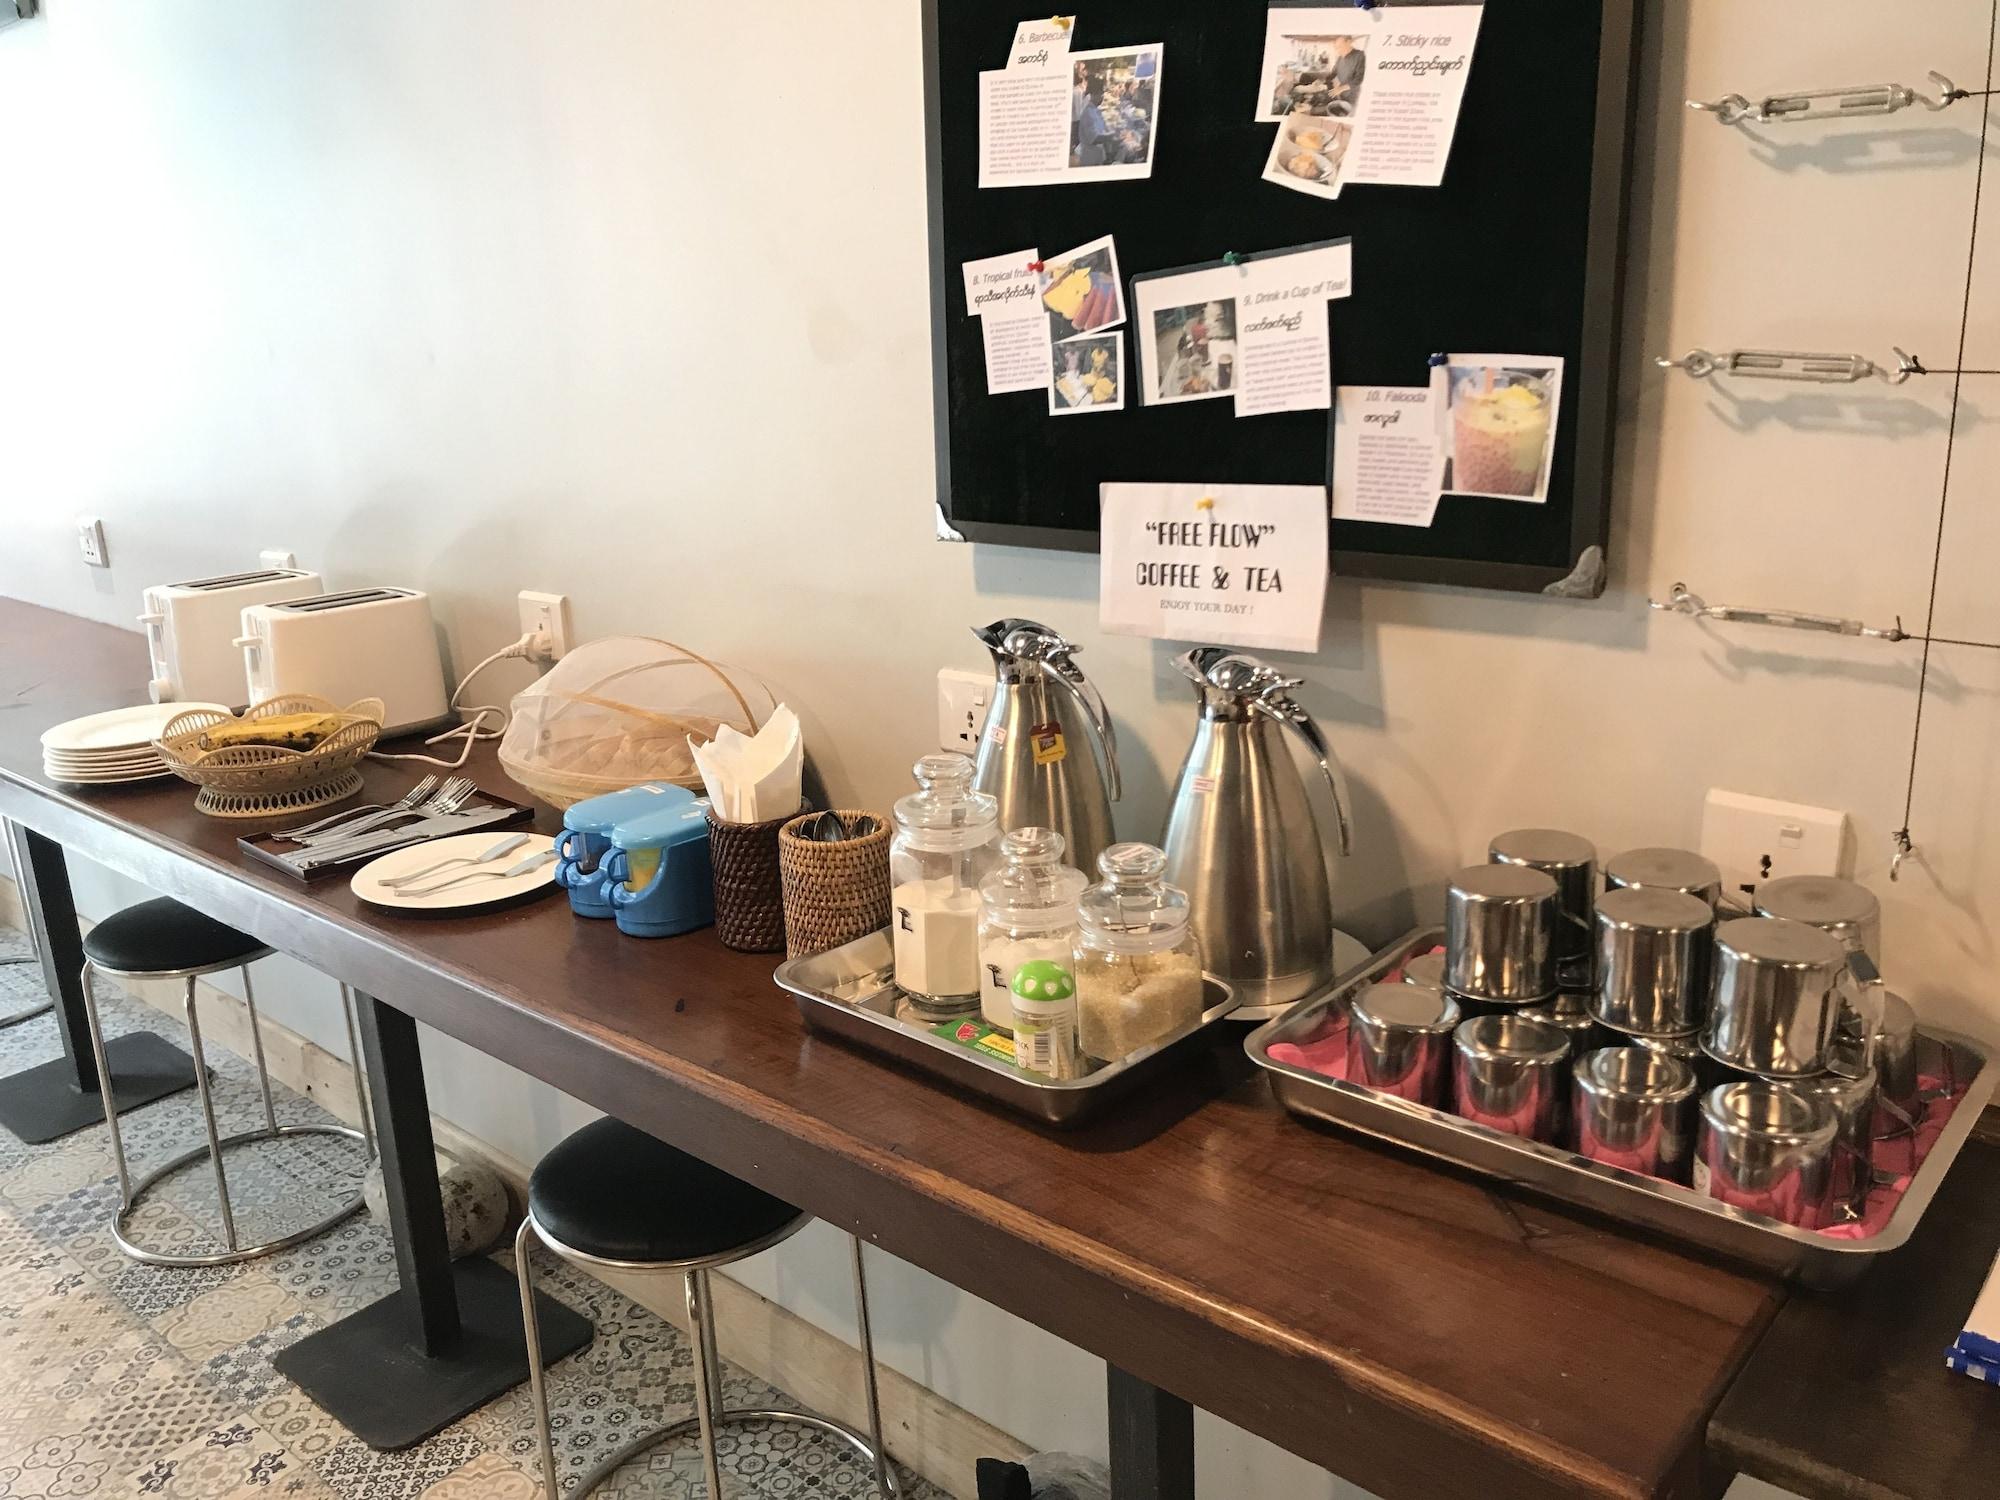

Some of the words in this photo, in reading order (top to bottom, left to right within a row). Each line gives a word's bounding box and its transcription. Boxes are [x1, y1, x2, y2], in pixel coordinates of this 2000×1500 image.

[1382, 34, 1392, 46] 7.
[1395, 34, 1429, 48] Sticky
[1430, 34, 1451, 46] rice
[983, 269, 1012, 284] Tropical
[1255, 290, 1280, 304] Drink
[1291, 286, 1310, 298] Cup
[1312, 281, 1324, 294] of
[1384, 389, 1426, 403] Falooda
[1146, 521, 1203, 547] “FREE
[1208, 522, 1276, 549] FLOW”
[1136, 562, 1200, 589] COFFEE
[1212, 565, 1230, 590] &
[1244, 567, 1283, 593] TEA
[1160, 599, 1191, 611] ENJOY
[1193, 601, 1221, 613] YOUR
[1224, 604, 1248, 615] DAY
